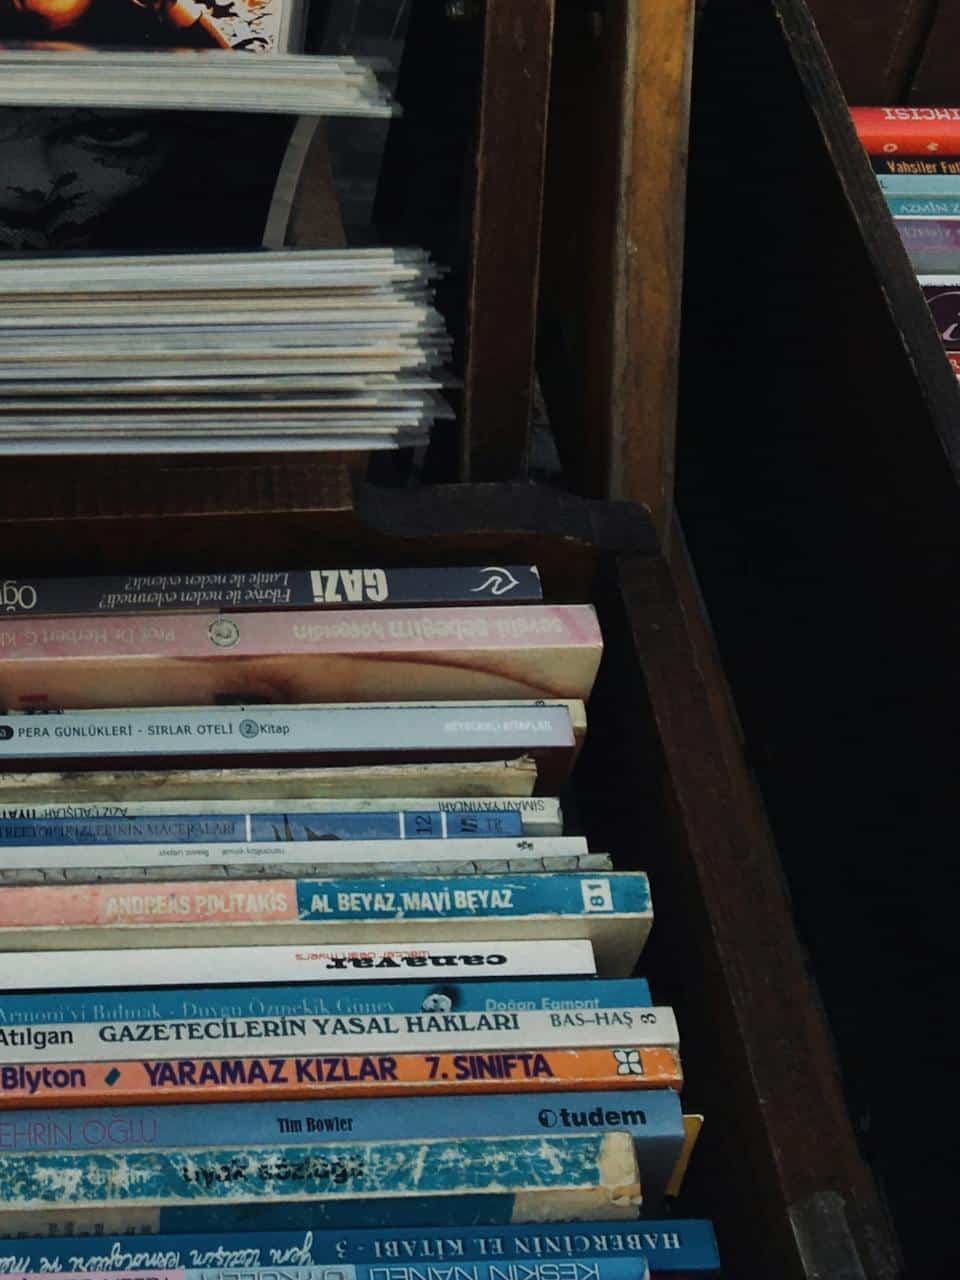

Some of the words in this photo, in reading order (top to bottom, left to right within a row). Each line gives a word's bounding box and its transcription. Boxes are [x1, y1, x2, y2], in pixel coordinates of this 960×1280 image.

[185, 575, 226, 588] neden
[97, 588, 177, 608] evlenmedi?
[180, 589, 223, 604] neden
[17, 727, 50, 738] PERA
[147, 724, 192, 737] SIRLAR
[260, 723, 290, 736] Kitap
[310, 893, 334, 913] AL
[401, 888, 451, 911] MAVİ
[455, 888, 515, 911] BEYAZ
[325, 953, 509, 970] canavar
[98, 1014, 307, 1043] GAZETECİLERİN
[314, 1014, 400, 1036] YASAL
[407, 1012, 521, 1034] HAKLARI
[1, 1065, 86, 1094] Blyton
[143, 1058, 289, 1087] YARAMAZ
[296, 1056, 399, 1083] KIZLAR
[425, 1055, 450, 1080] 7.
[455, 1053, 555, 1080] SINIFTA
[277, 1117, 304, 1133] Tim
[306, 1116, 354, 1133] Bowler
[559, 1106, 647, 1128] tudem
[82, 1115, 159, 1146] OĞLU
[335, 1240, 348, 1258] 3
[373, 1238, 465, 1261] KİTABI
[474, 1237, 505, 1256] EL
[514, 1232, 682, 1257] HABERCİNİN
